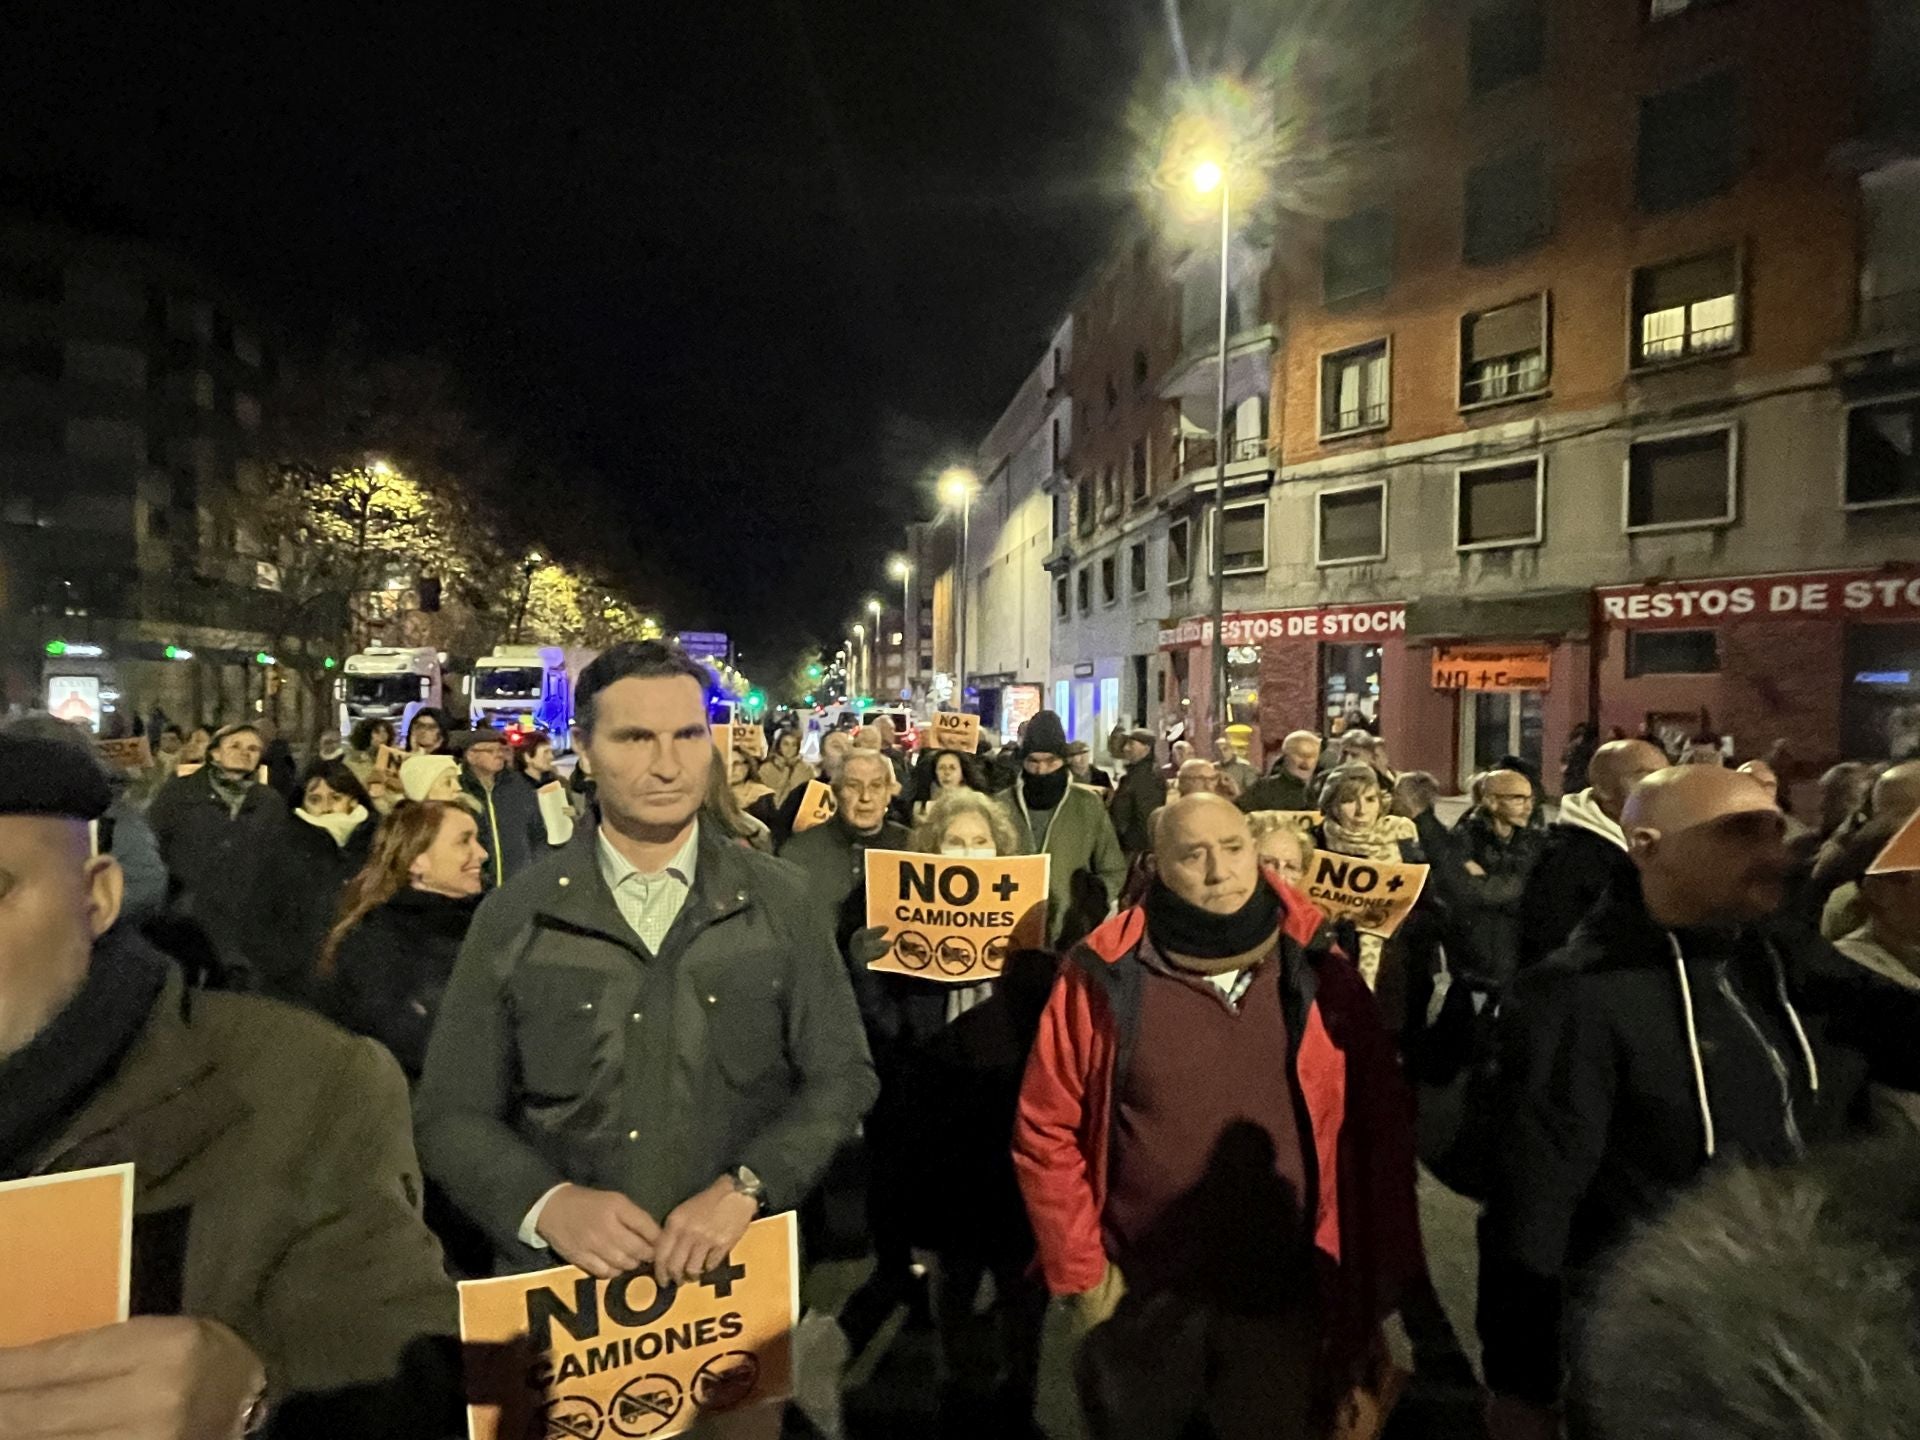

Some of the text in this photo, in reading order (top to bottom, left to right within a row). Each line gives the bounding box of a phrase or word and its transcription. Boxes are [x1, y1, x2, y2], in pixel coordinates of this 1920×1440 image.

[1604, 587, 1755, 619] RESTOS
[1769, 584, 1828, 611] DE
[1202, 610, 1406, 640] RESTOS DE STOCK
[939, 714, 960, 728] NO
[899, 860, 1019, 906] NO +
[1315, 857, 1404, 893] NO +
[895, 906, 1014, 928] CAMIONES
[526, 1253, 746, 1350] NO +
[528, 1311, 744, 1390] CAMIONES
